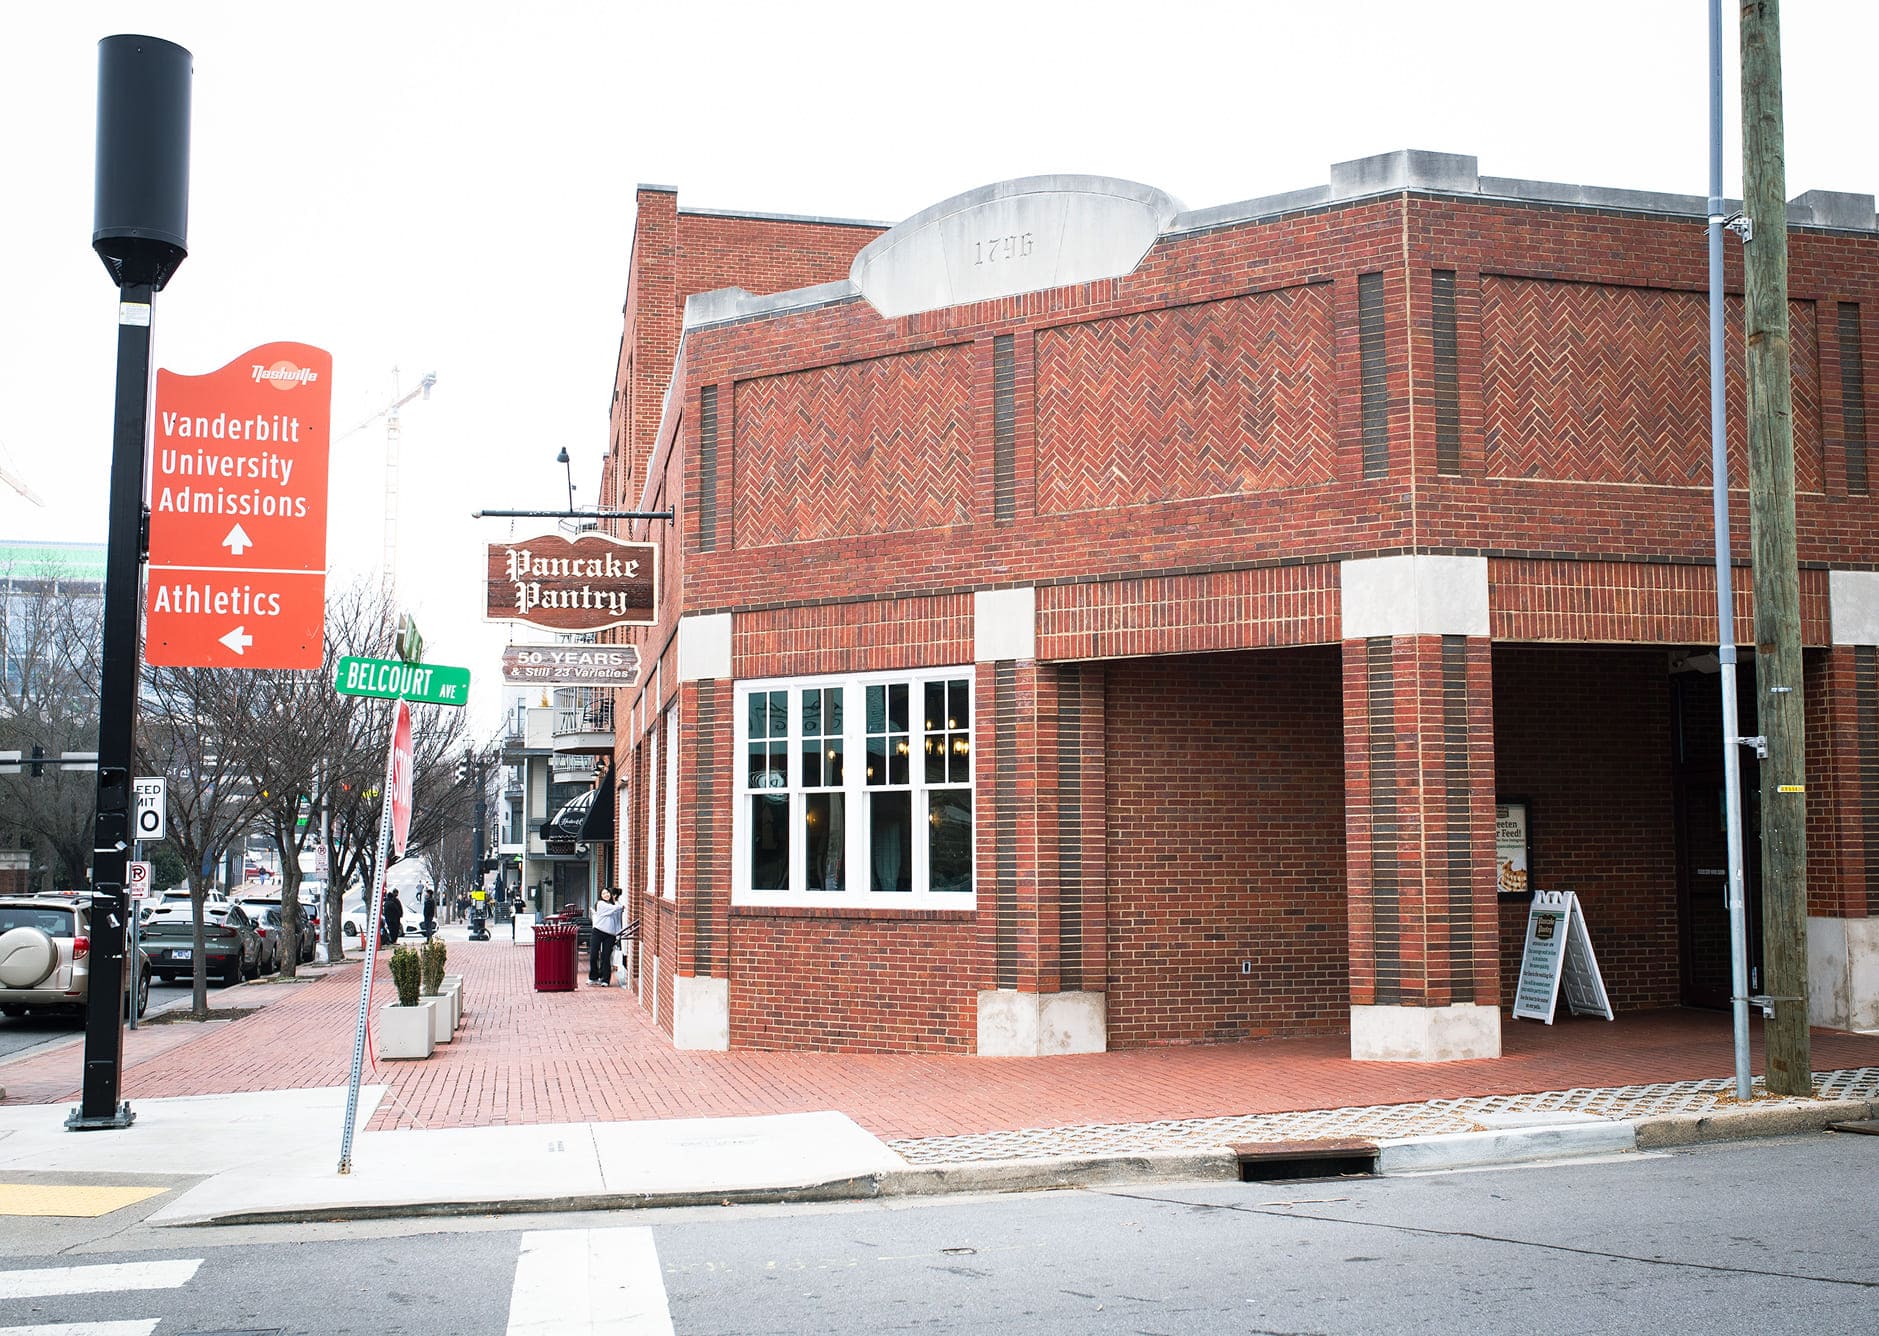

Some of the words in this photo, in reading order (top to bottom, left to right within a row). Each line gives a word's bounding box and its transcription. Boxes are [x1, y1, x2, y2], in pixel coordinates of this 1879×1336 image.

[975, 232, 1033, 265] 1796
[251, 364, 318, 385] Nashville
[162, 411, 299, 442] Vanderbilt
[161, 448, 293, 486] University
[158, 486, 307, 517] Admissions
[505, 549, 639, 582] Pancake
[154, 584, 281, 615] Athletics
[514, 581, 628, 616] Pantry
[511, 667, 519, 677] &
[526, 667, 549, 677] Still
[554, 668, 570, 677] 23
[575, 668, 629, 678] Varieties
[517, 652, 543, 664] 50
[550, 652, 623, 665] YEARS
[346, 661, 433, 696] BELCOURT
[439, 684, 457, 699] AVE
[136, 785, 161, 795] EED
[140, 810, 159, 831] 0
[1501, 829, 1521, 838] Feed!
